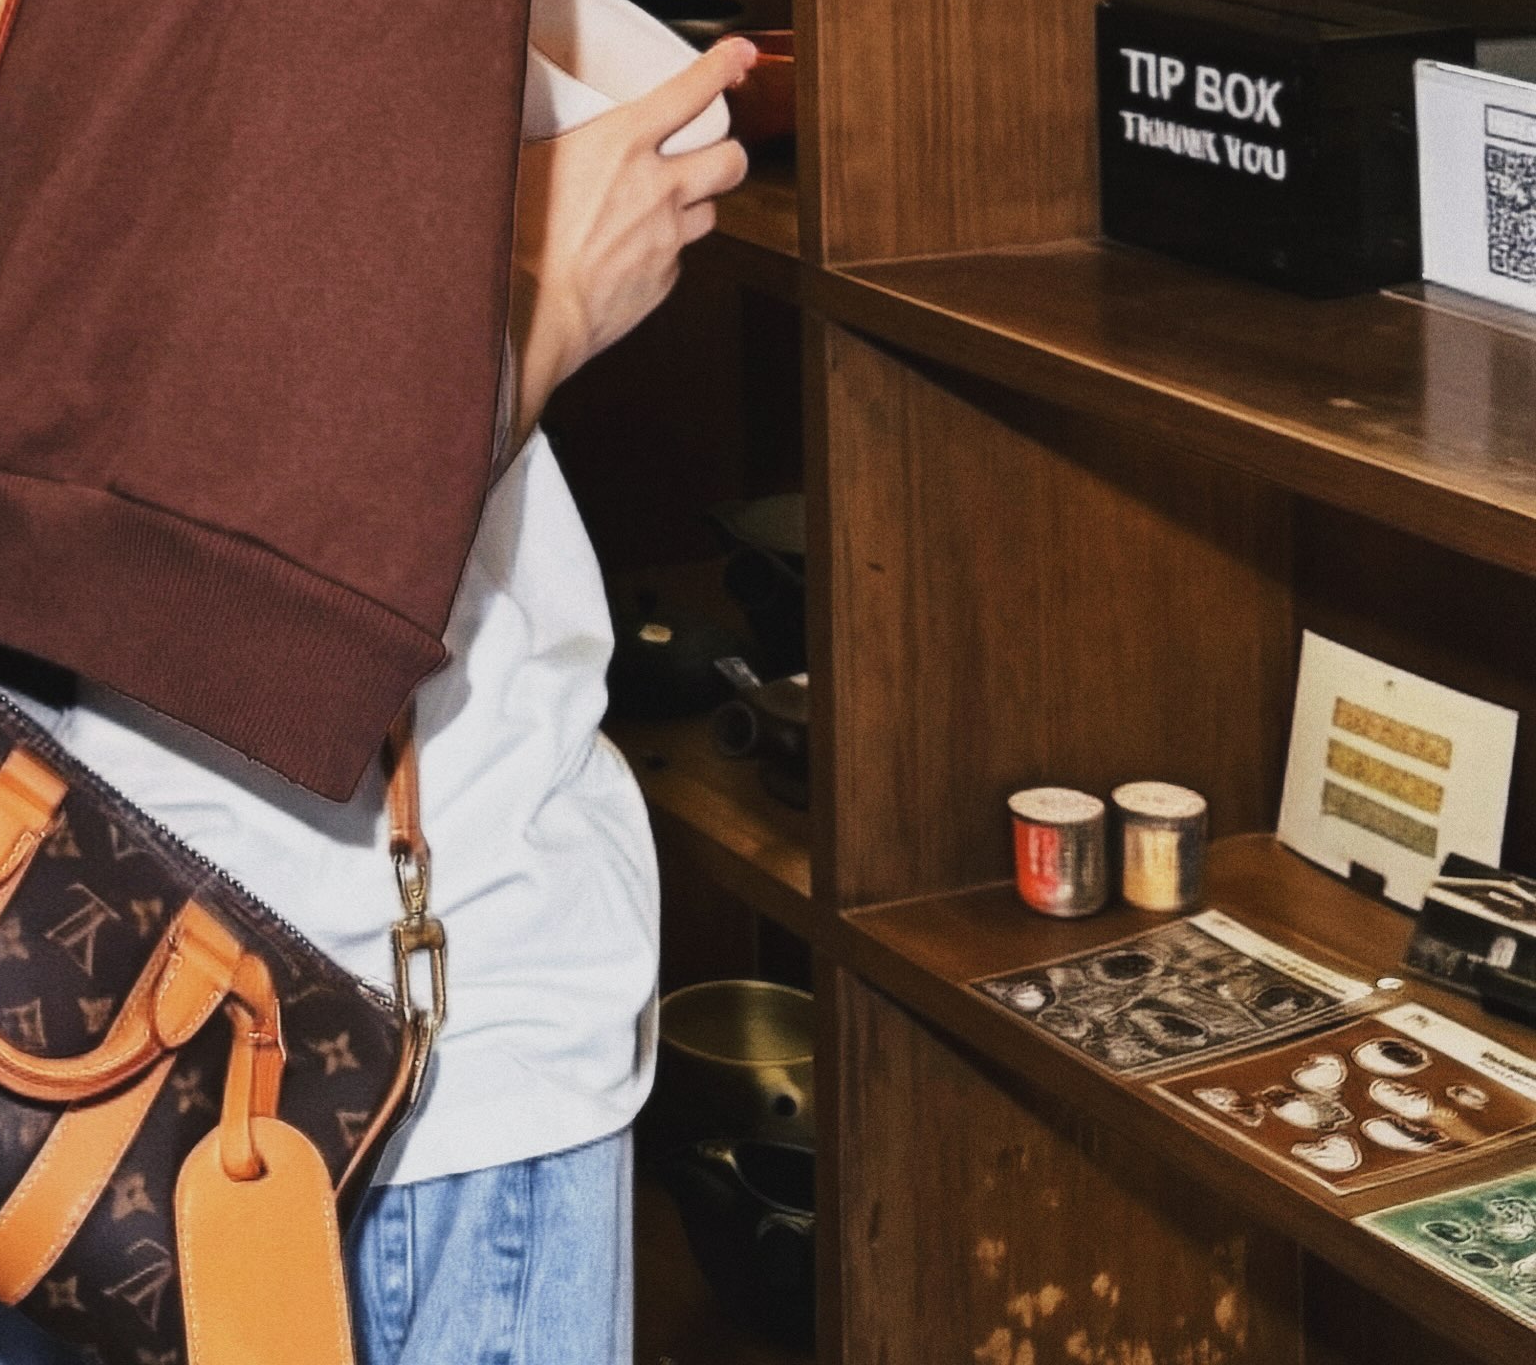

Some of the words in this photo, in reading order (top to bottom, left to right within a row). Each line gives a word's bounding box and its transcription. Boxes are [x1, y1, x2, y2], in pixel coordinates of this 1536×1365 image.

[1119, 47, 1186, 102] TIP
[1194, 65, 1283, 129] BOX
[1118, 110, 1220, 164] THANK
[1223, 134, 1287, 181] YOU
